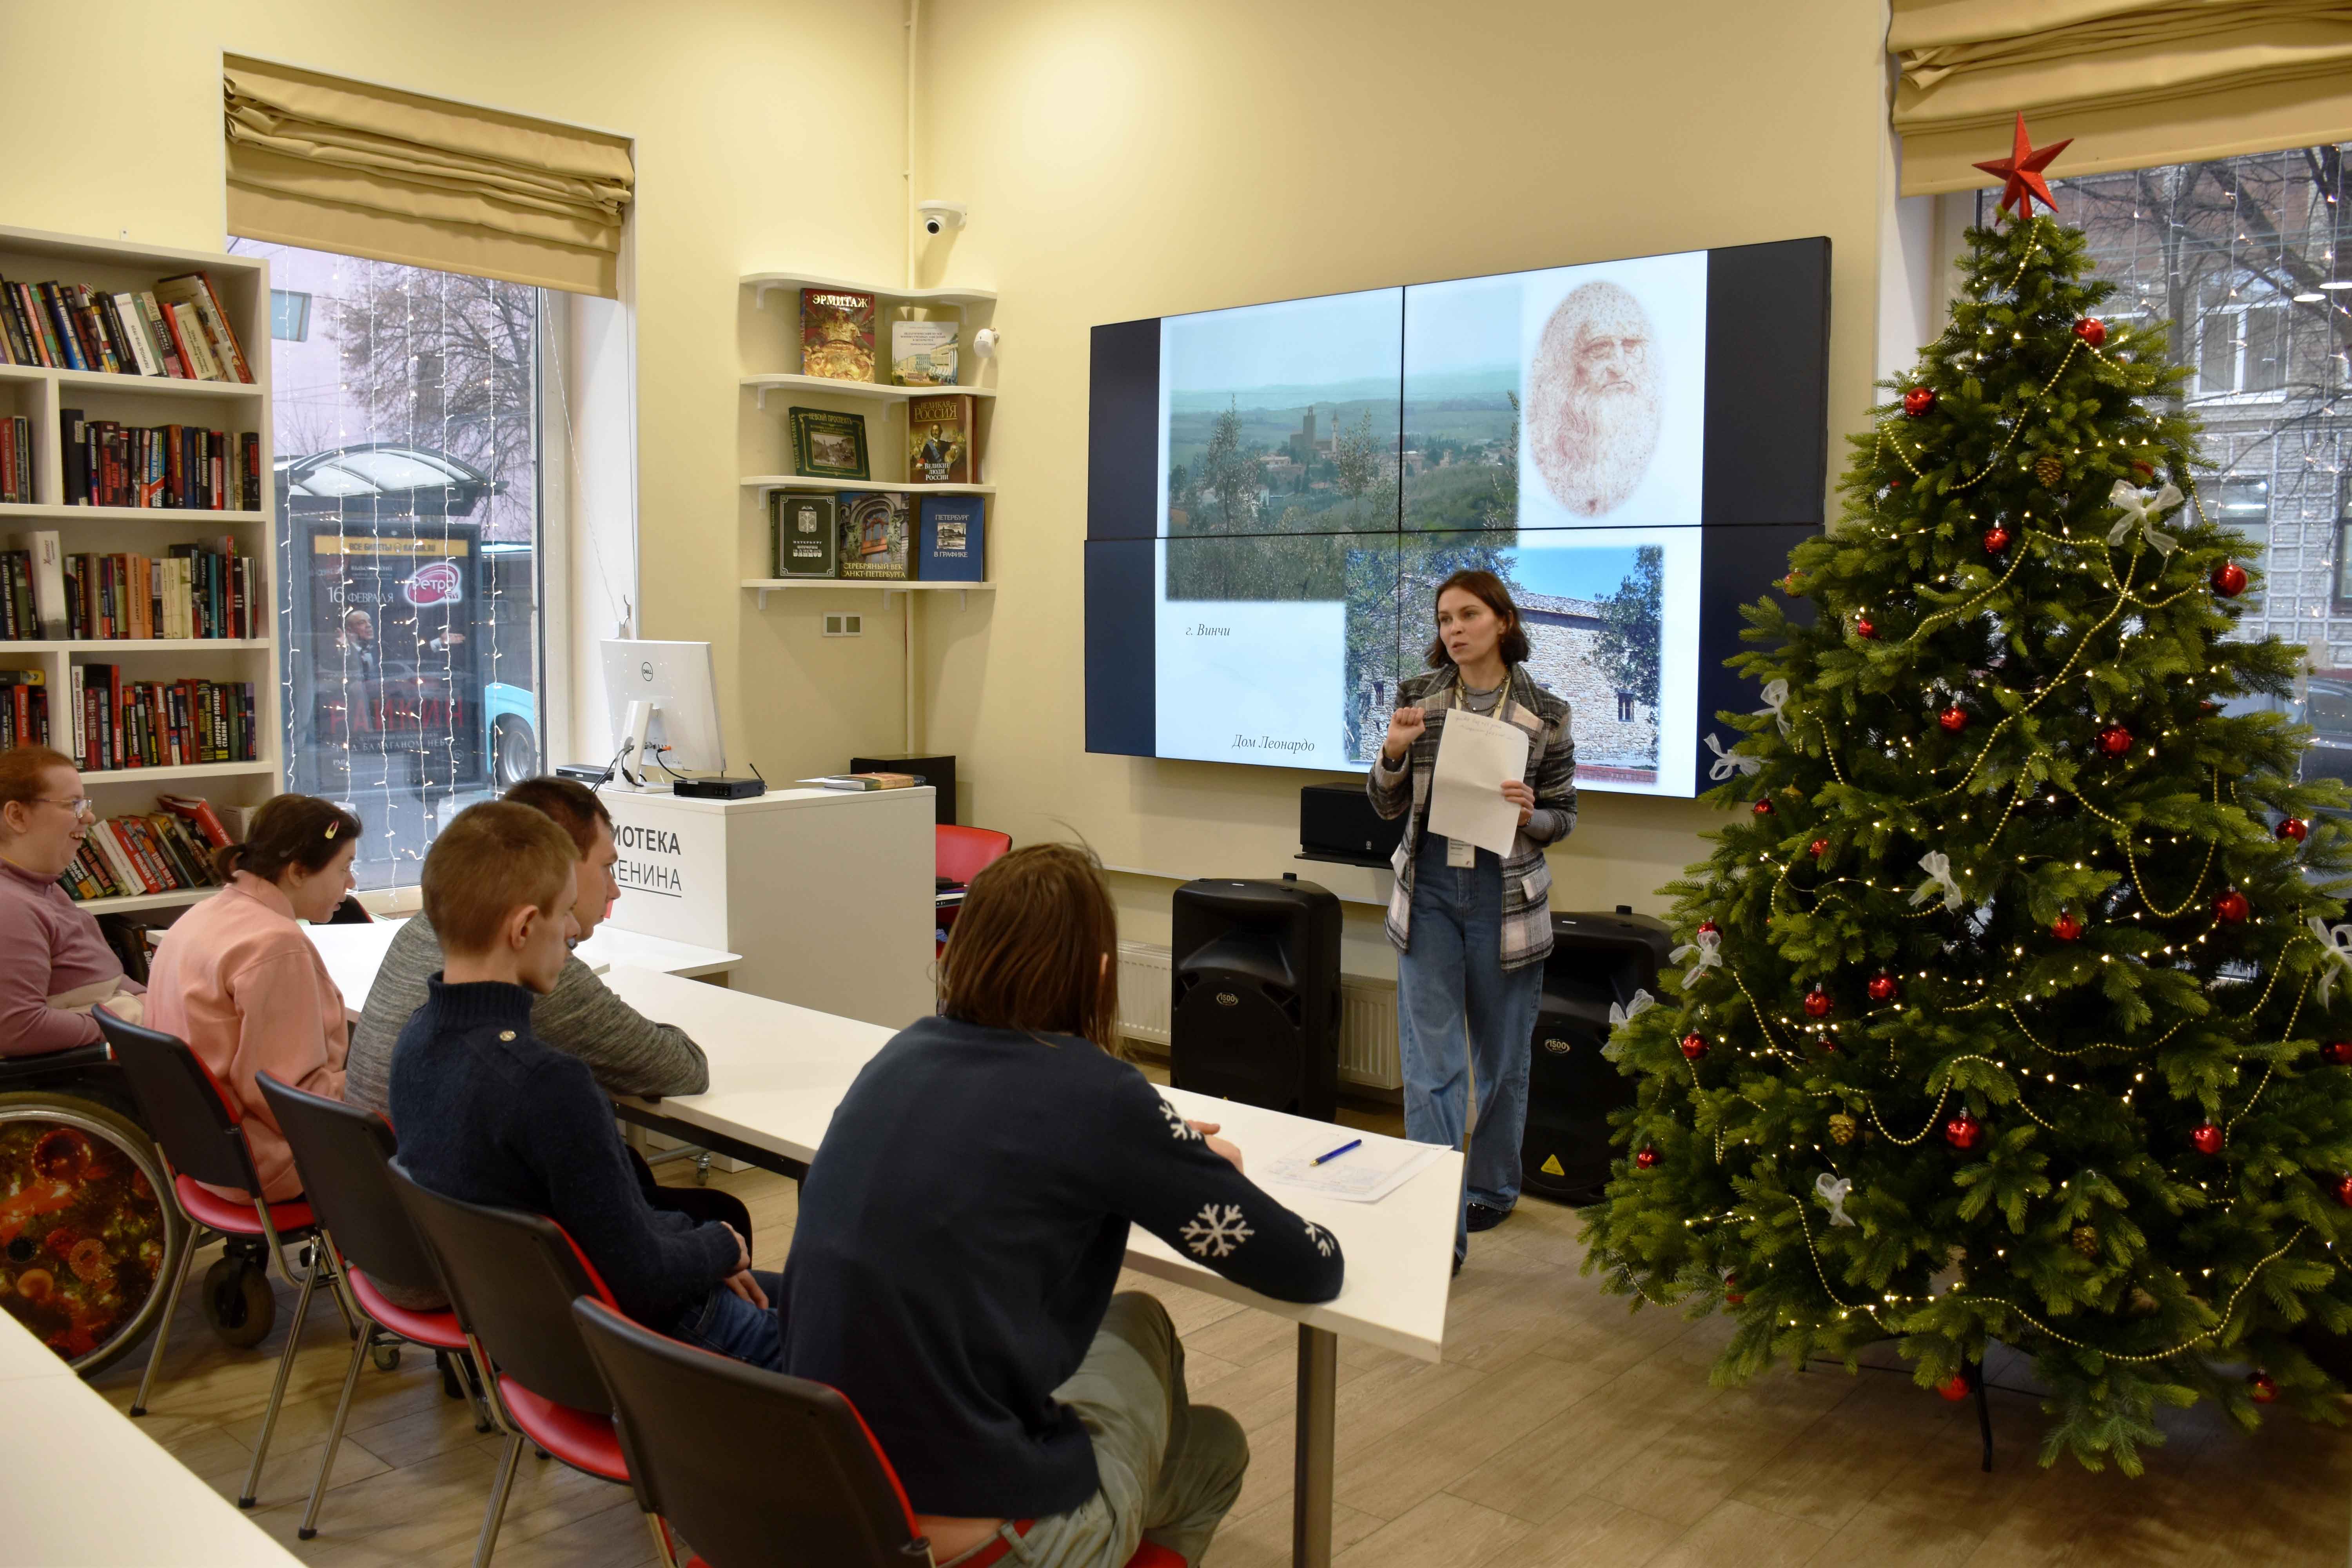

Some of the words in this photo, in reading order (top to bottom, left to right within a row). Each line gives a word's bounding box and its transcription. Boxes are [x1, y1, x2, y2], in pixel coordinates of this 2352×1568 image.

[813, 294, 869, 308] ЭРМИТАЖ
[139, 348, 151, 369] ПЕРИОД
[914, 405, 957, 420] РОССИЯ
[349, 543, 360, 551] ВСЕ
[412, 576, 455, 594] Ретро
[327, 587, 343, 603] 16
[348, 592, 394, 603] ФЕВРАЛЯ
[1186, 627, 1193, 636] г.
[1197, 624, 1230, 636] Винчи
[88, 699, 96, 728] 1941-1945
[1232, 734, 1256, 749] Дом
[1259, 736, 1315, 754] Леонардо
[1220, 993, 1235, 1002] 1500
[1550, 1040, 1566, 1049] 1500
